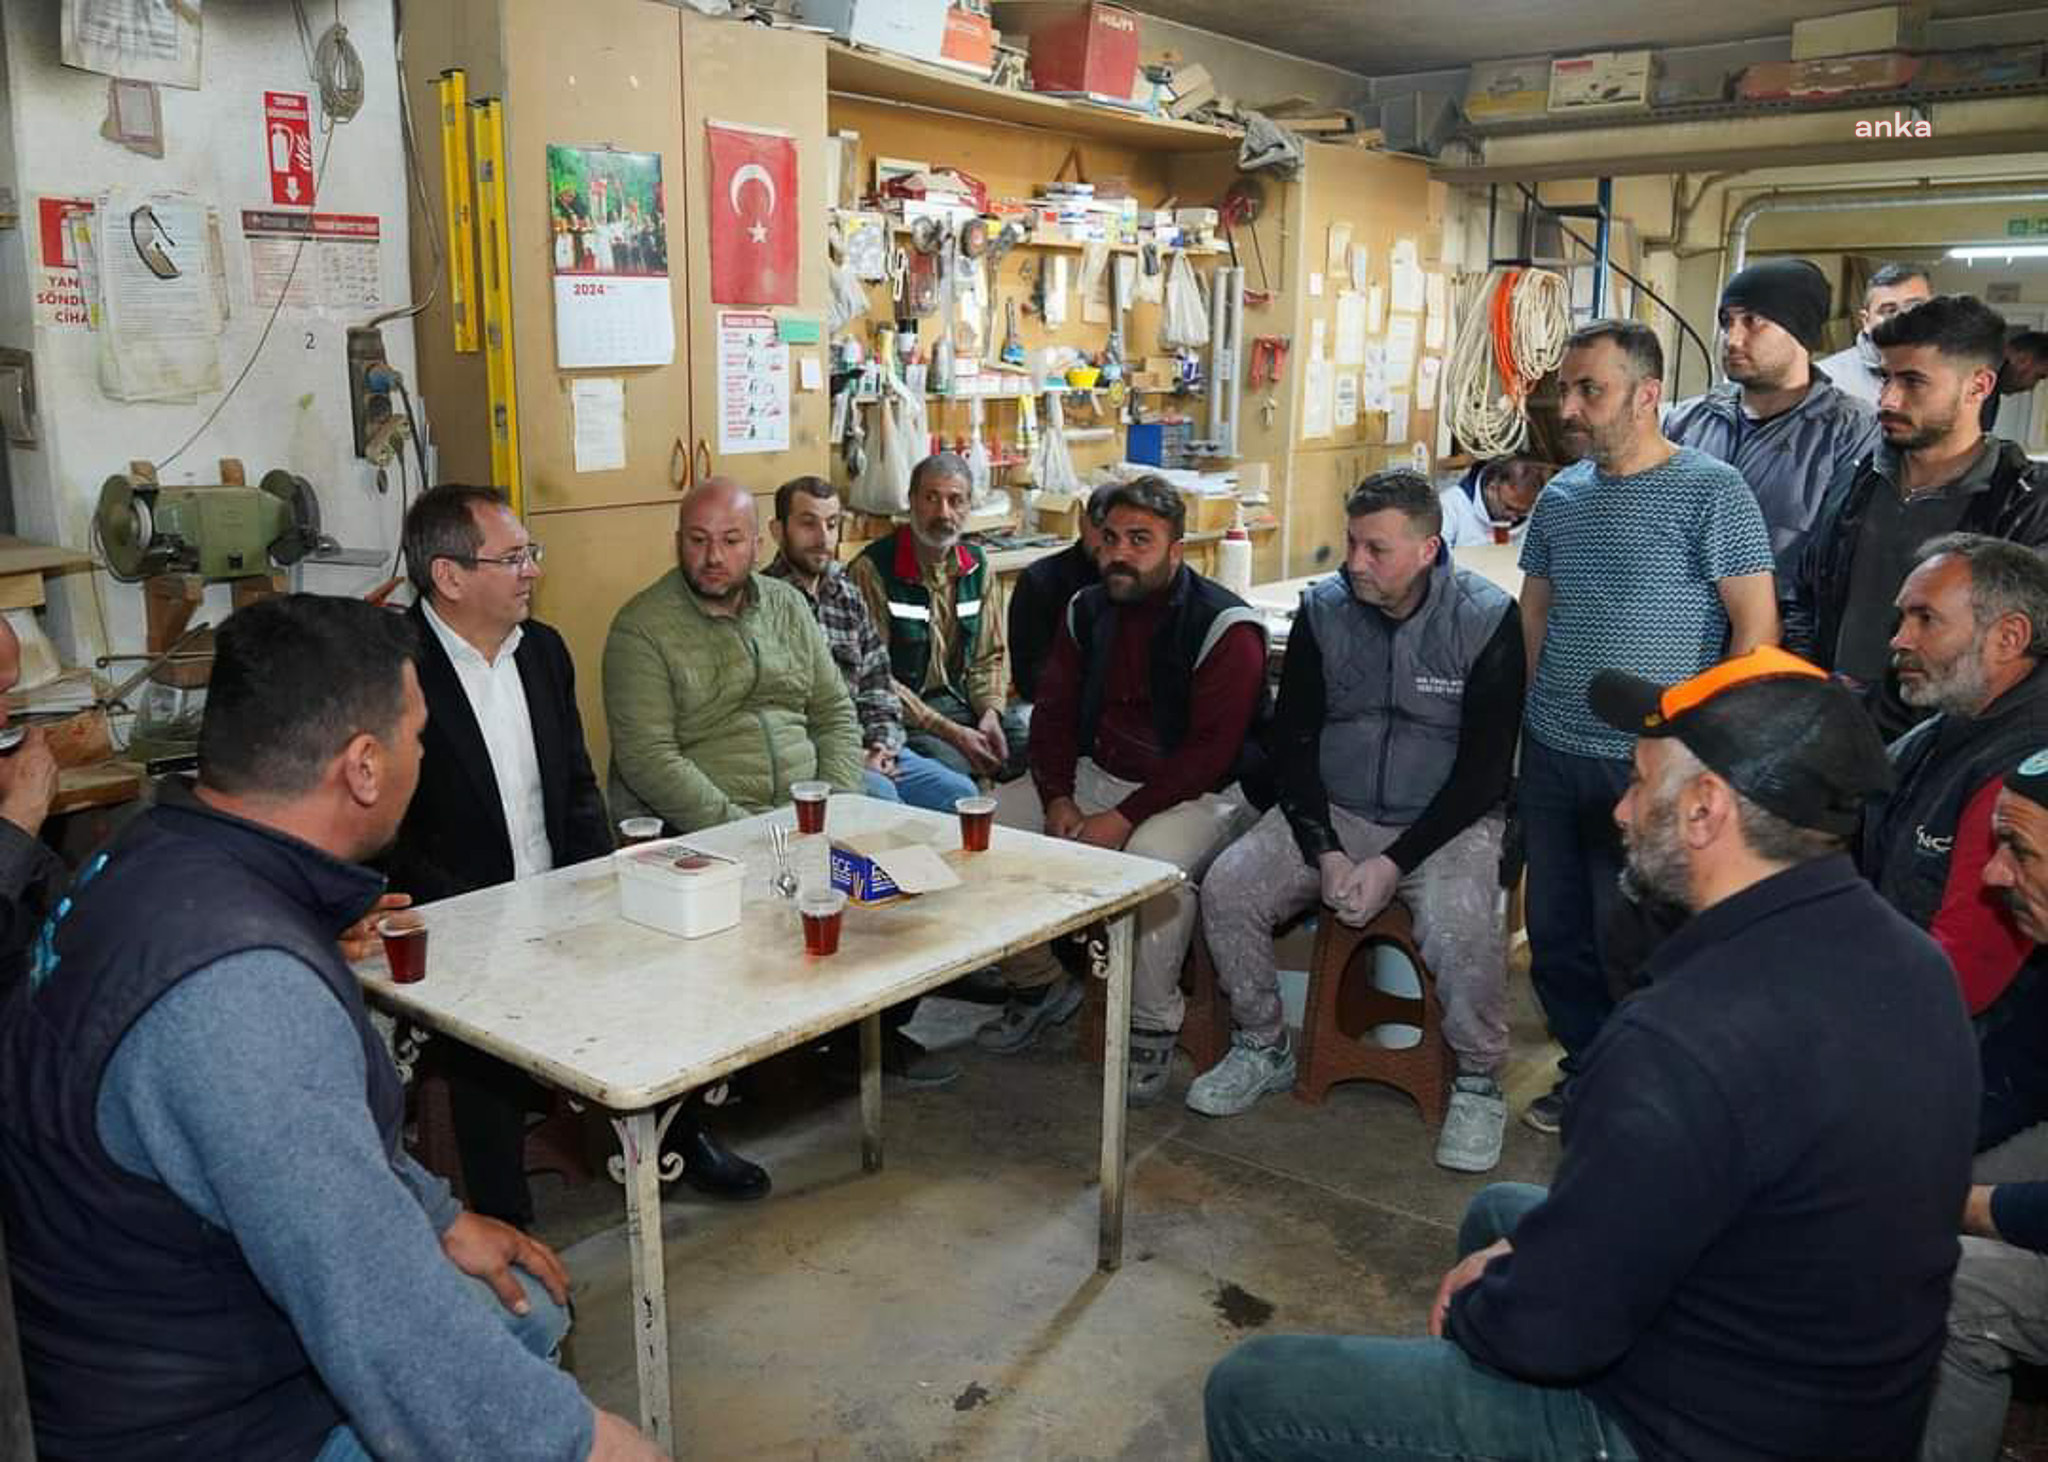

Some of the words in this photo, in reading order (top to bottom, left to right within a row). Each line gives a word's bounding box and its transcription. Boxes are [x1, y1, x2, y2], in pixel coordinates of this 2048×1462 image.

[48, 276, 79, 288] YAN
[574, 283, 604, 295] 2024
[55, 308, 90, 323] CİHA
[305, 333, 316, 349] 2
